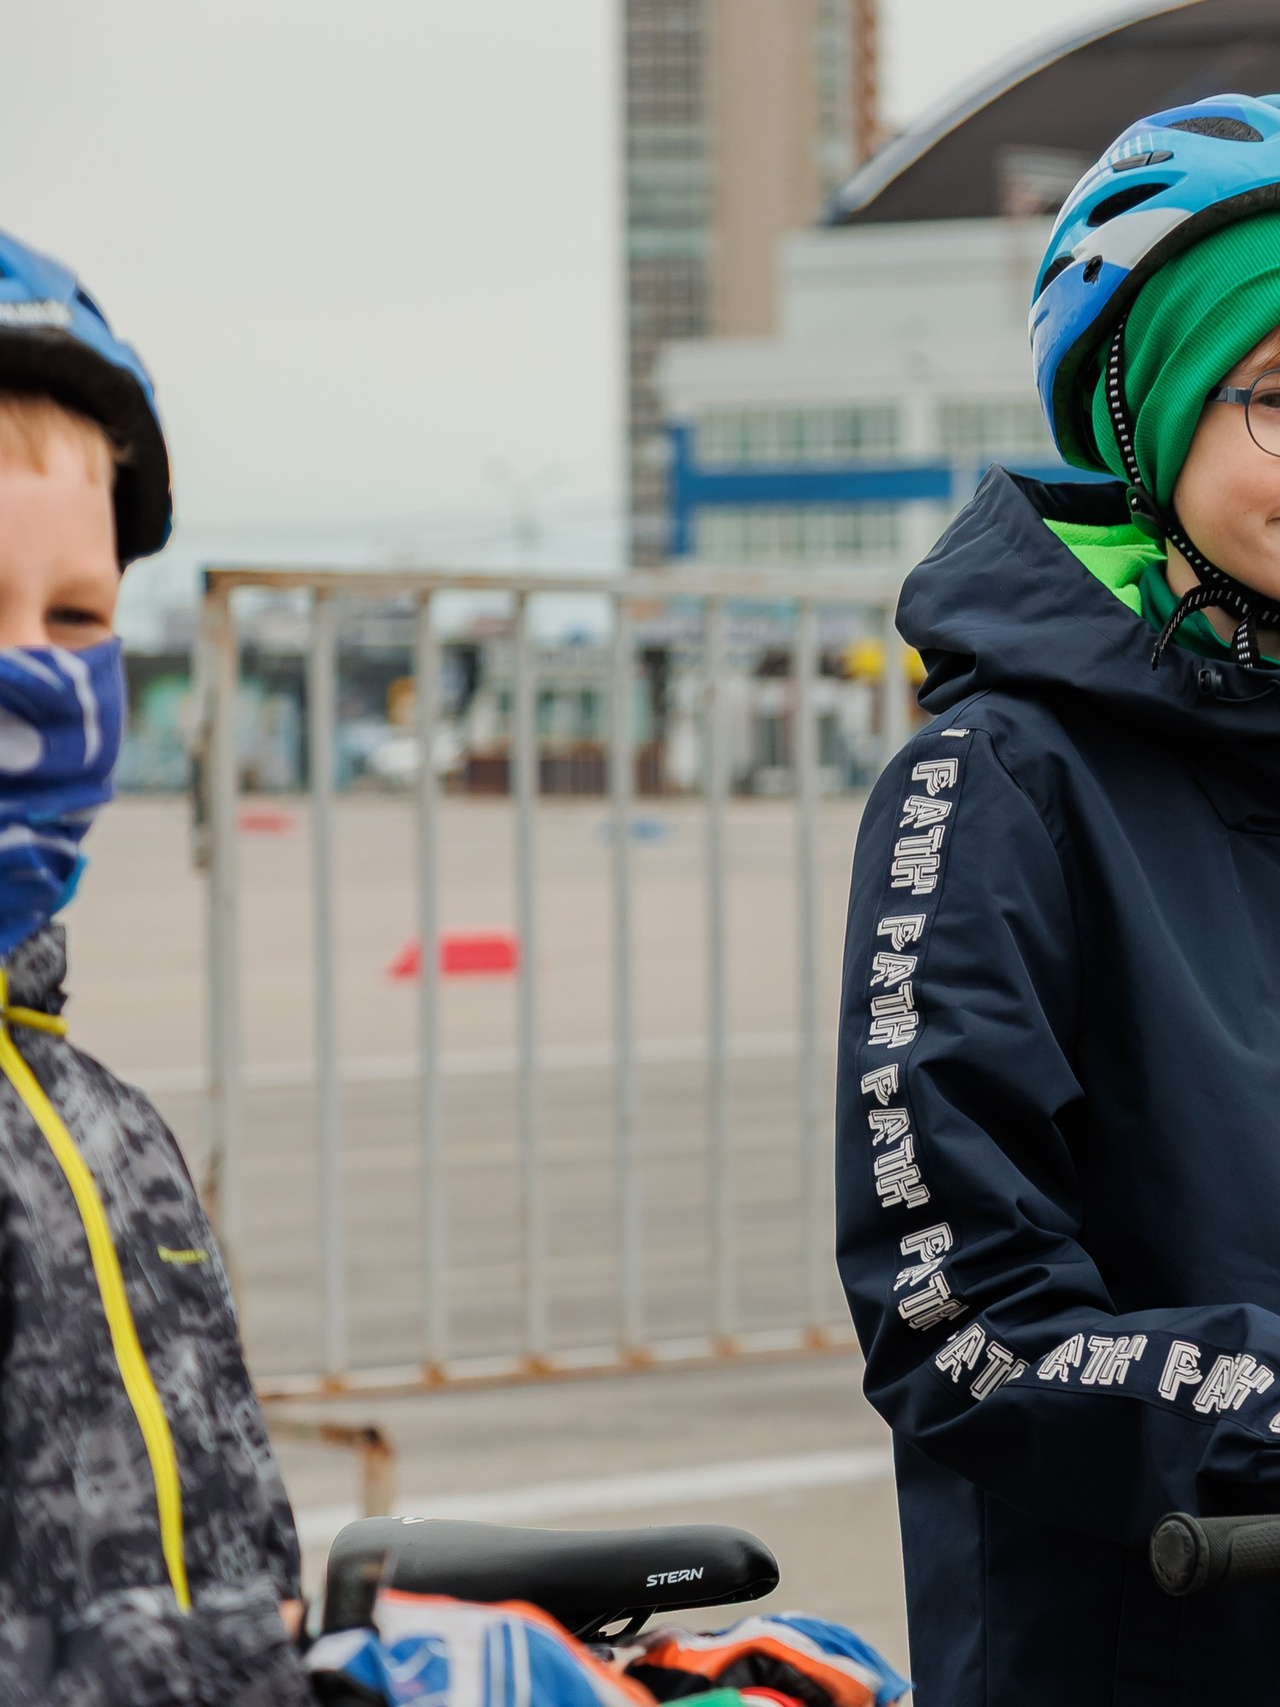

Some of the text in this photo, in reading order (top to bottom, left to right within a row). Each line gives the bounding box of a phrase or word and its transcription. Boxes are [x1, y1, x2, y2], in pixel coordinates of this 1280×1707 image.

[890, 757, 959, 895] PATH
[867, 913, 927, 1049] PATH
[860, 1063, 931, 1209] PATH
[1036, 1333, 1148, 1385] ATH
[646, 1566, 704, 1588] STERN
